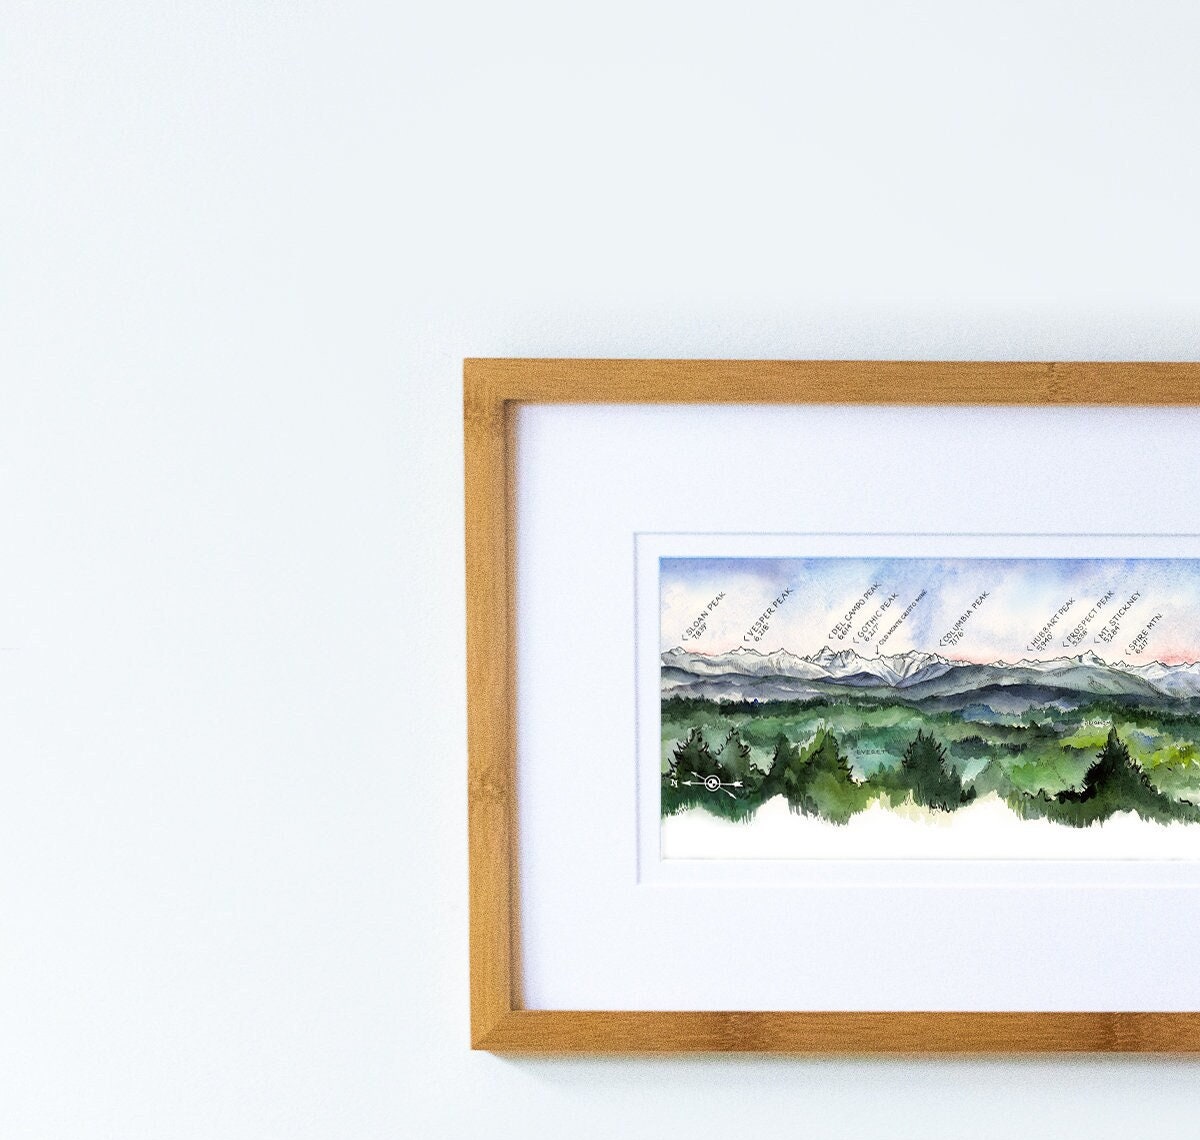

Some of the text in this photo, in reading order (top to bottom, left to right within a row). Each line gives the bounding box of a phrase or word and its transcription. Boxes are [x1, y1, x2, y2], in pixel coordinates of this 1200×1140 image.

[686, 592, 726, 636] SLOAN PEAK
[747, 588, 794, 636] VESPER PEAK
[831, 582, 882, 636] DEL CAMPO PEAK
[857, 592, 899, 639] GOTHIC PEAK
[878, 634, 889, 645] OLD
[887, 619, 903, 635] MONTE
[901, 602, 917, 620] CRISTO
[942, 590, 990, 643] COLUMBIA PEAK
[1031, 597, 1076, 647] HUBBART PEAK
[1066, 590, 1115, 643] PROSPECT PEAK
[1108, 590, 1141, 626] STICKNEY
[1128, 629, 1149, 651] SPIRE
[670, 778, 679, 789] N
